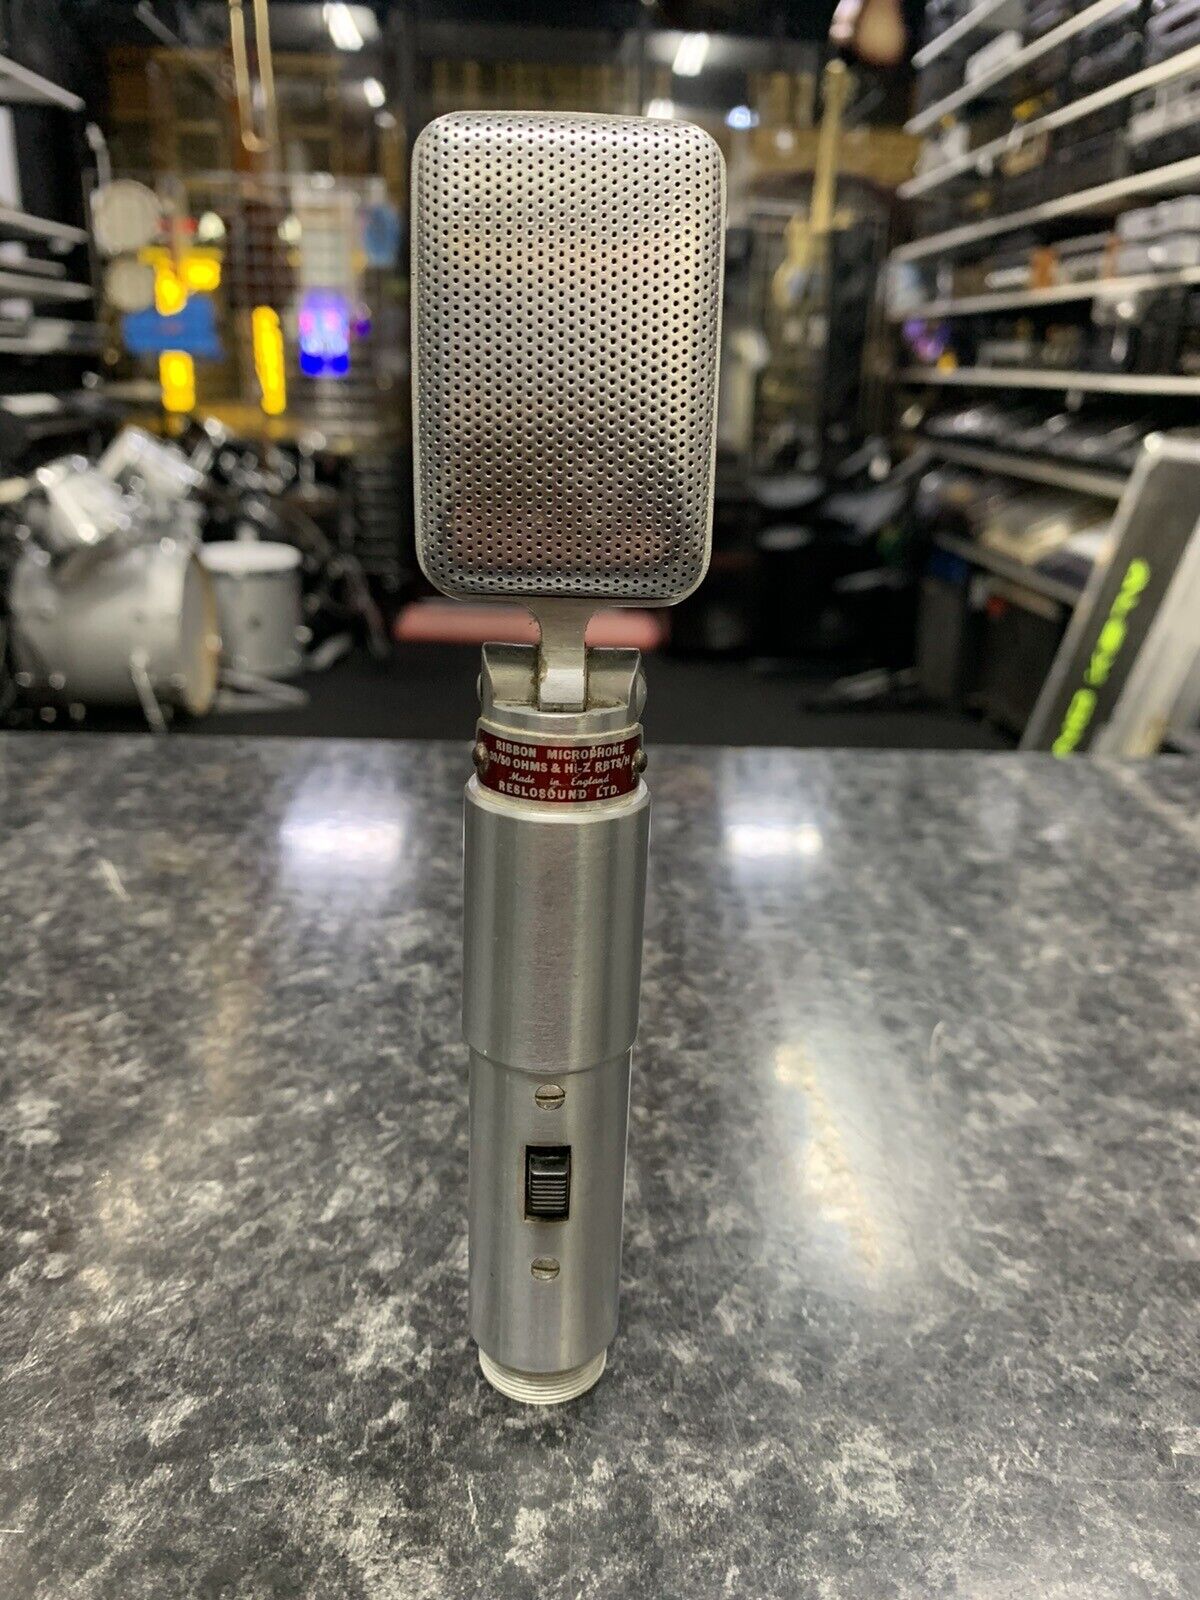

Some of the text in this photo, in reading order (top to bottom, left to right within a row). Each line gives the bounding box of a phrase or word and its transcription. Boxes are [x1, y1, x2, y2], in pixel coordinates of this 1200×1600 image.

[495, 739, 625, 760] RIBBON MICROPHONE
[513, 758, 548, 773] OHMS
[550, 762, 562, 774] &
[508, 771, 610, 788] Made in England
[499, 780, 620, 800] RESLOSOUND LTD.
